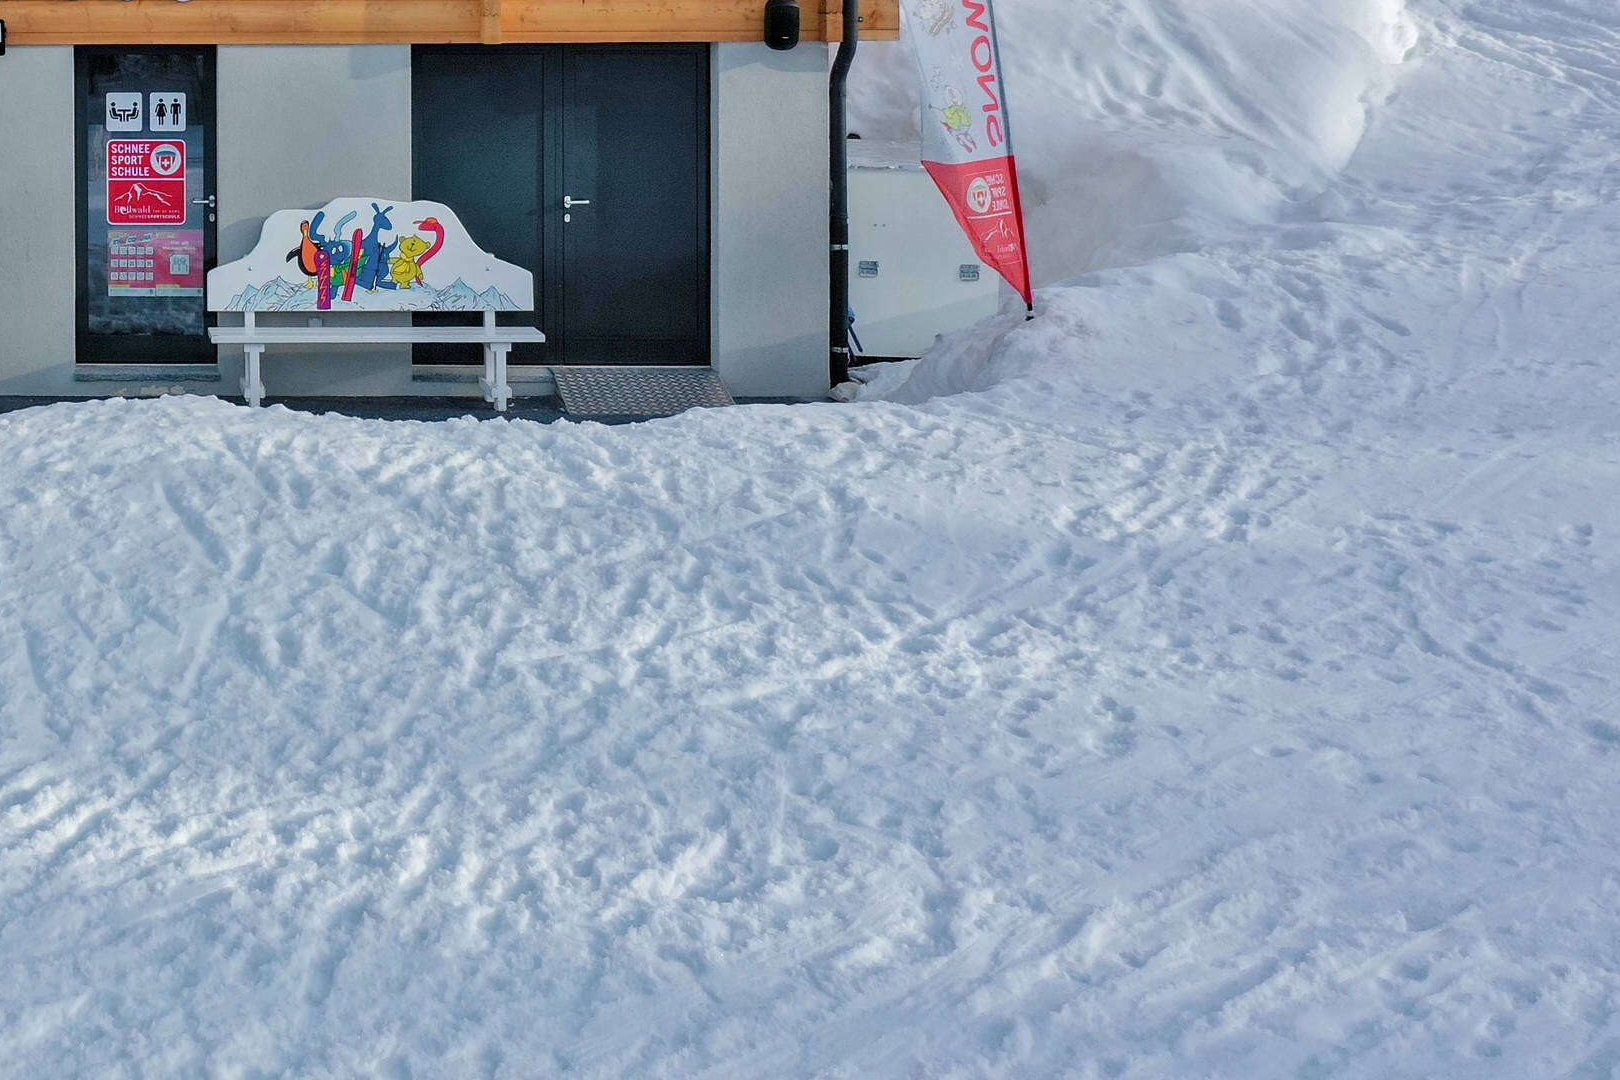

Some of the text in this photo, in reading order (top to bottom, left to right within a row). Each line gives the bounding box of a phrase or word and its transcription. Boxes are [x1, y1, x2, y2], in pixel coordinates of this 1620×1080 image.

[111, 143, 150, 154] SCHNEE
[111, 155, 143, 165] SPORT
[111, 166, 150, 177] SCHULE
